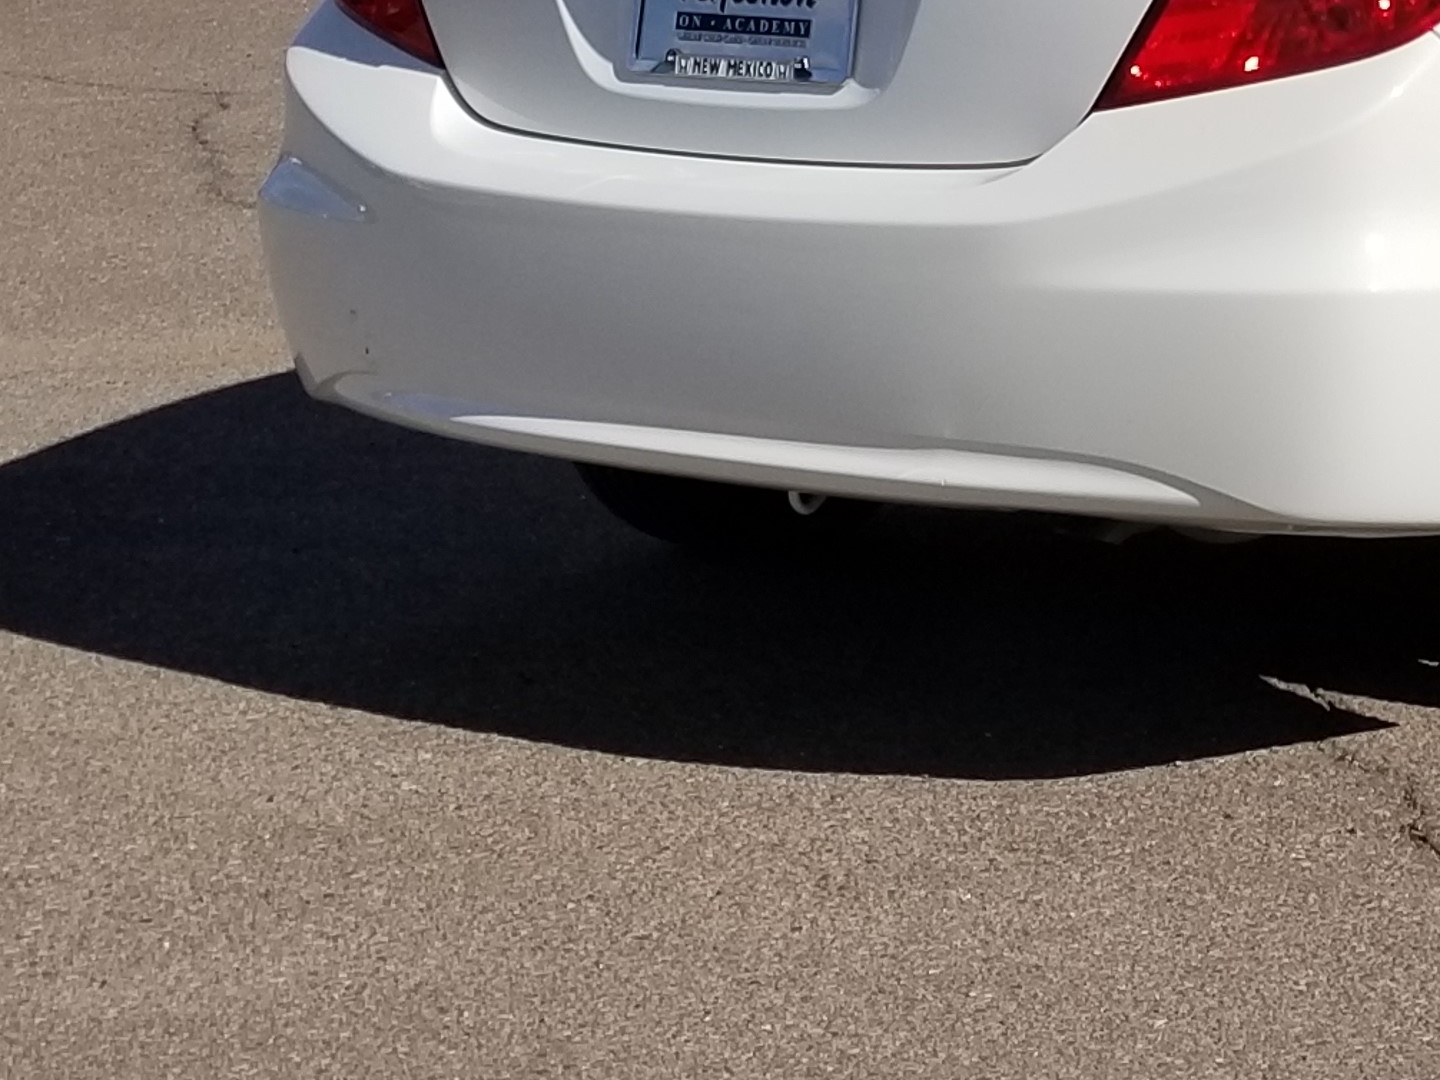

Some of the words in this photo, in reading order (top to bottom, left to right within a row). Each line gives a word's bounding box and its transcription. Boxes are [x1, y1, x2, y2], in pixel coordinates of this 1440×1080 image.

[679, 14, 702, 28] ON
[722, 17, 809, 35] ACADEMY
[693, 57, 721, 75] NEW
[727, 59, 774, 78] MEXICO
